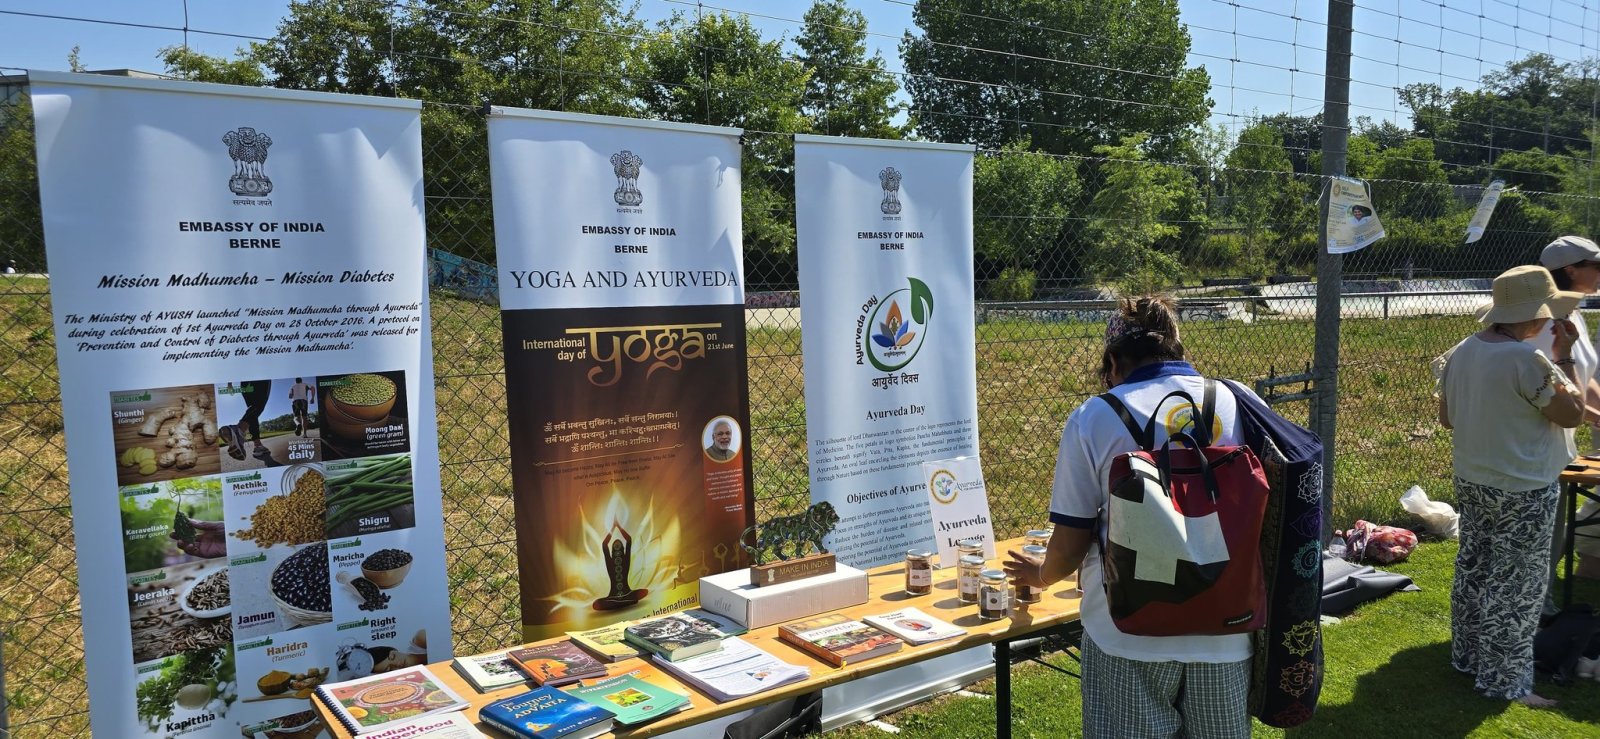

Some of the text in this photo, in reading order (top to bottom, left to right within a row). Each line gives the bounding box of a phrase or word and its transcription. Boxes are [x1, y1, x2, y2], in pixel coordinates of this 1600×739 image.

[179, 221, 325, 233] EMBASSY OF INDIA
[582, 225, 677, 236] EMBASSY OF INDIA
[857, 231, 924, 239] EMBASSY OF INDIA
[229, 238, 281, 249] BERNE
[614, 245, 648, 254] BERNE
[97, 269, 395, 289] Mission Madhumeha Mission Diabetes
[509, 270, 739, 289] YOGA AND AYURVEDA
[64, 313, 84, 325] The
[88, 312, 136, 324] Ministry
[141, 310, 152, 323] of
[155, 310, 193, 321] AYUSH
[196, 308, 241, 319] launched
[287, 304, 343, 315] Madhumeha
[346, 303, 380, 314] through
[68, 328, 105, 339] during
[110, 325, 167, 337] celebration
[171, 324, 184, 335] of
[185, 323, 201, 333] 1st
[204, 321, 249, 334] Ayurveda
[252, 320, 272, 332] Day
[275, 321, 285, 329] on
[289, 319, 302, 328] 28
[305, 317, 338, 327] October
[341, 316, 365, 326] 2016.
[368, 316, 375, 324] A
[378, 315, 410, 326] protocol
[855, 294, 878, 365] Ayurveda Day
[140, 338, 160, 348] and
[164, 336, 201, 347] Control
[204, 335, 215, 346] of
[219, 333, 260, 344] Diabetes
[263, 330, 299, 342] through
[351, 330, 368, 338] was
[371, 327, 403, 336] released
[406, 327, 418, 337] for
[522, 337, 586, 350] International
[706, 332, 718, 341] on
[721, 342, 735, 350] June
[162, 347, 230, 363] implementing
[234, 346, 250, 356] the
[557, 323, 715, 387] day of yoga
[871, 372, 919, 390] आयुर्वेद दिवस
[114, 409, 144, 419] Shunthi
[866, 404, 925, 421] Ayurveda Day
[365, 423, 404, 434] Moong Daal
[288, 450, 315, 460] daily
[233, 480, 268, 491] Methika
[846, 482, 927, 505] Objectives of Ayurve
[359, 516, 390, 527] Shigru
[938, 514, 987, 532] Ayurveda
[125, 524, 169, 536] Karavellaka
[333, 552, 365, 562] Maricha
[779, 565, 800, 575] MAKE
[801, 563, 809, 571] IN
[810, 559, 829, 569] INDIA
[133, 587, 176, 602] Jeeraka
[652, 593, 698, 616] International
[237, 611, 275, 625] Jamun
[370, 616, 396, 628] Right
[371, 630, 397, 641] sleep
[266, 641, 308, 656] Haridra
[271, 650, 306, 663] (Turmeric)
[506, 693, 552, 713] Journey
[514, 698, 567, 719] ADVAITA
[166, 712, 215, 733] Kapittha
[386, 719, 454, 739] perfood
[365, 724, 417, 739] Indian
